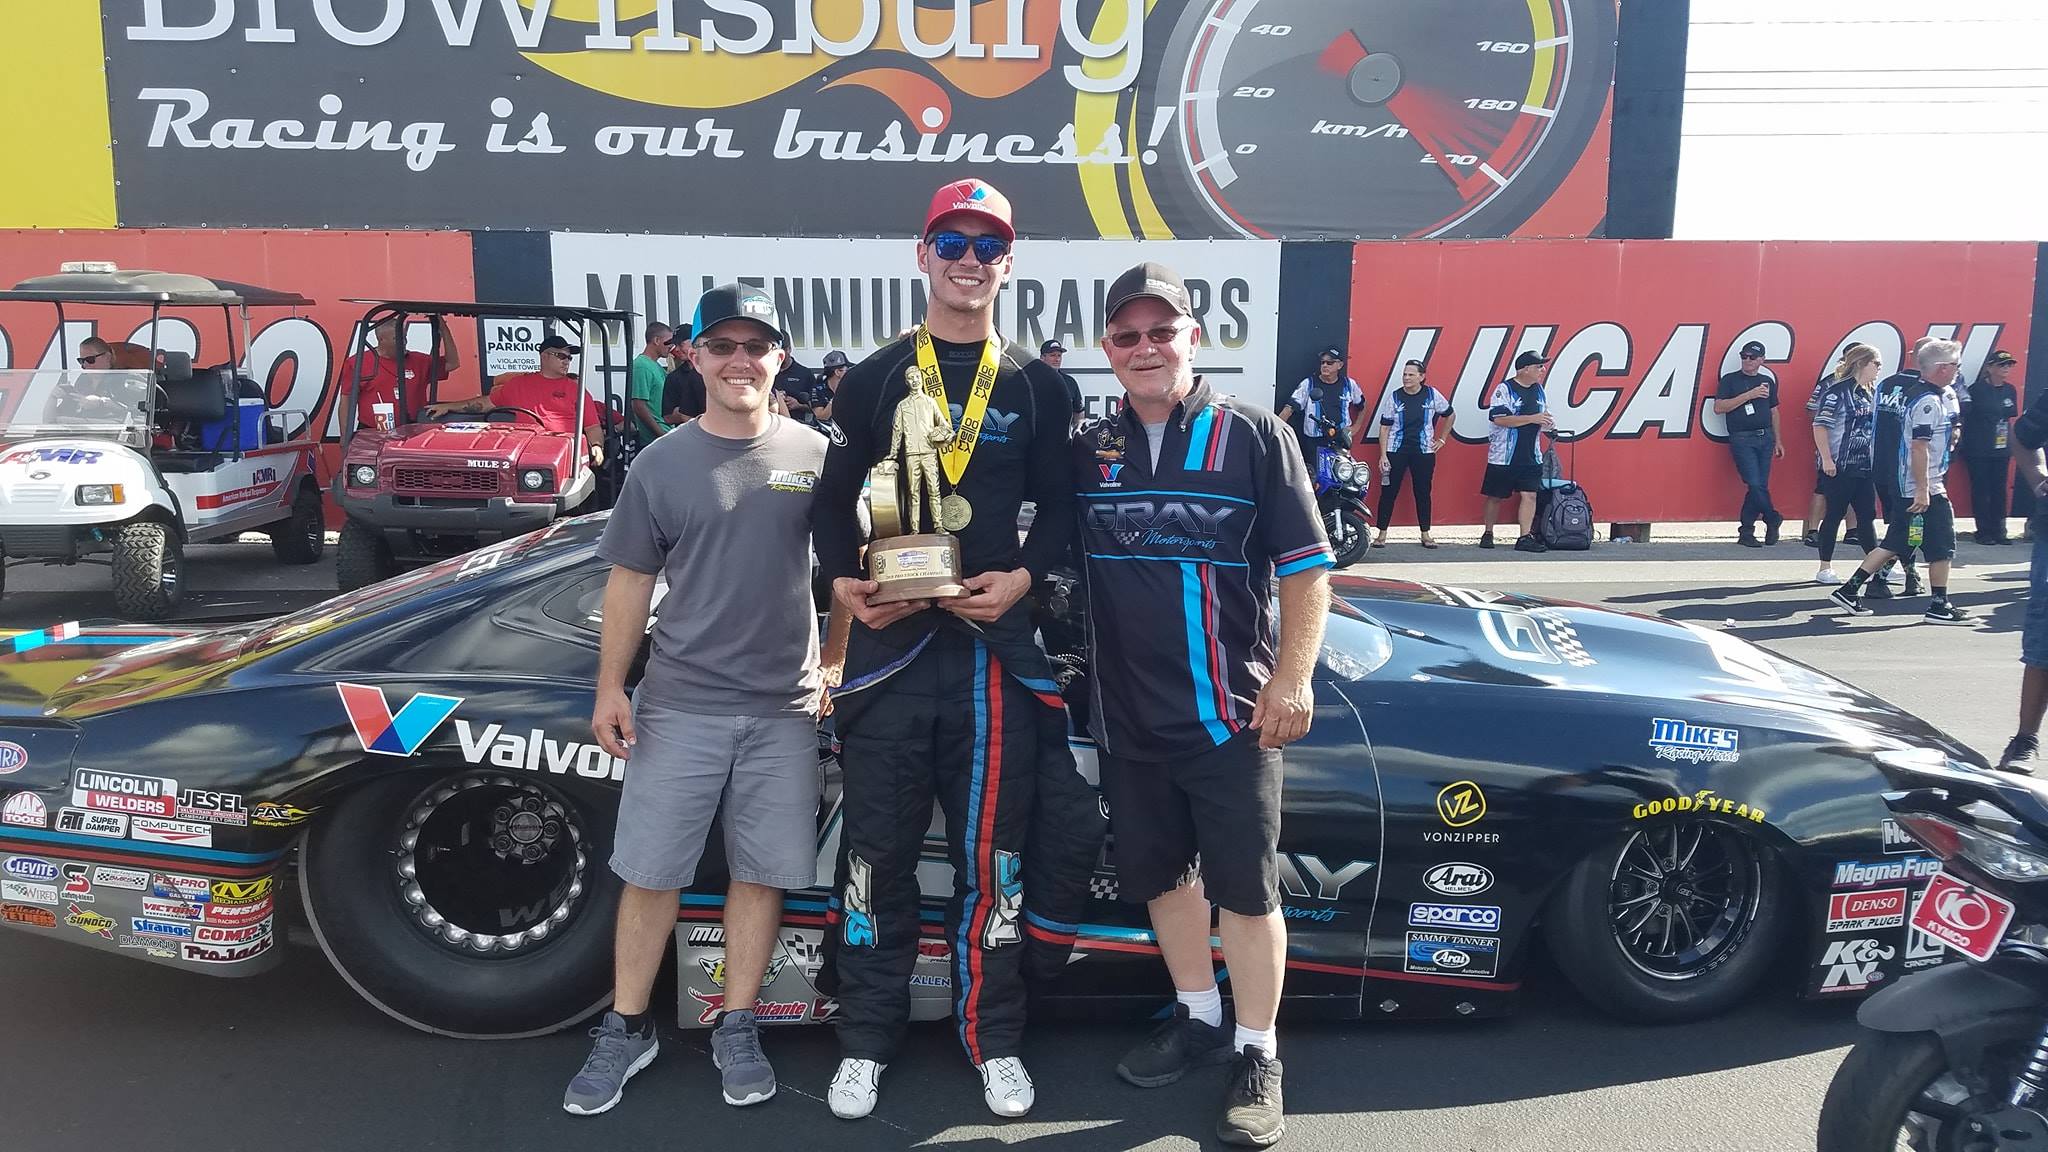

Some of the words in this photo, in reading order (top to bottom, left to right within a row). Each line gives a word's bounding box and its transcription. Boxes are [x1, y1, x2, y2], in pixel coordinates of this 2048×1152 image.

[1250, 23, 1292, 37] 40
[1475, 40, 1530, 54] 160
[1233, 86, 1275, 99] 20
[1463, 98, 1518, 111] 180
[138, 87, 455, 172] Racing
[485, 97, 566, 154] is
[595, 117, 745, 158] our
[773, 105, 1177, 165] business!
[1310, 119, 1409, 139] km/h
[1234, 144, 1258, 154] 0
[584, 272, 932, 348] MILNNIU
[993, 277, 1251, 349] RAIRS
[497, 326, 532, 343] NO
[487, 342, 542, 352] PARKING
[467, 459, 500, 469] MULE
[502, 461, 511, 469] 2
[1099, 481, 1122, 489] Valvoline
[1086, 501, 1237, 535] GRAY
[1141, 529, 1222, 553] Motorsports
[455, 719, 627, 781] Valvol
[1655, 747, 1701, 764] Racing
[79, 772, 159, 797] LINCOLN
[6, 793, 44, 816] MAC
[95, 793, 165, 814] WELDERS
[178, 790, 247, 813] JESEL
[6, 813, 45, 825] TOOLS
[90, 815, 119, 826] SUPER
[132, 818, 212, 835] COMPUTECH
[85, 822, 121, 834] DAMPER
[1423, 831, 1500, 843] VONZIPPER
[6, 856, 54, 877] CLEVITE
[154, 873, 208, 889] FEL-PRO
[1428, 867, 1485, 887] Arai
[144, 902, 199, 916] VICTORY
[211, 897, 270, 915] PENSKE
[1851, 897, 1898, 912] DENSO
[70, 915, 113, 928] SUNOCO
[1413, 905, 1498, 924] sparco
[1828, 918, 1866, 931] SPARK
[1867, 915, 1903, 927] PLUGS
[133, 919, 192, 936] Strange
[198, 926, 258, 943] COMP
[1925, 919, 1971, 947] KYMCO
[119, 934, 177, 951] DIAMOND
[1411, 933, 1450, 943] SAMMY
[1451, 935, 1494, 947] TANNER
[1436, 951, 1465, 964] Arai
